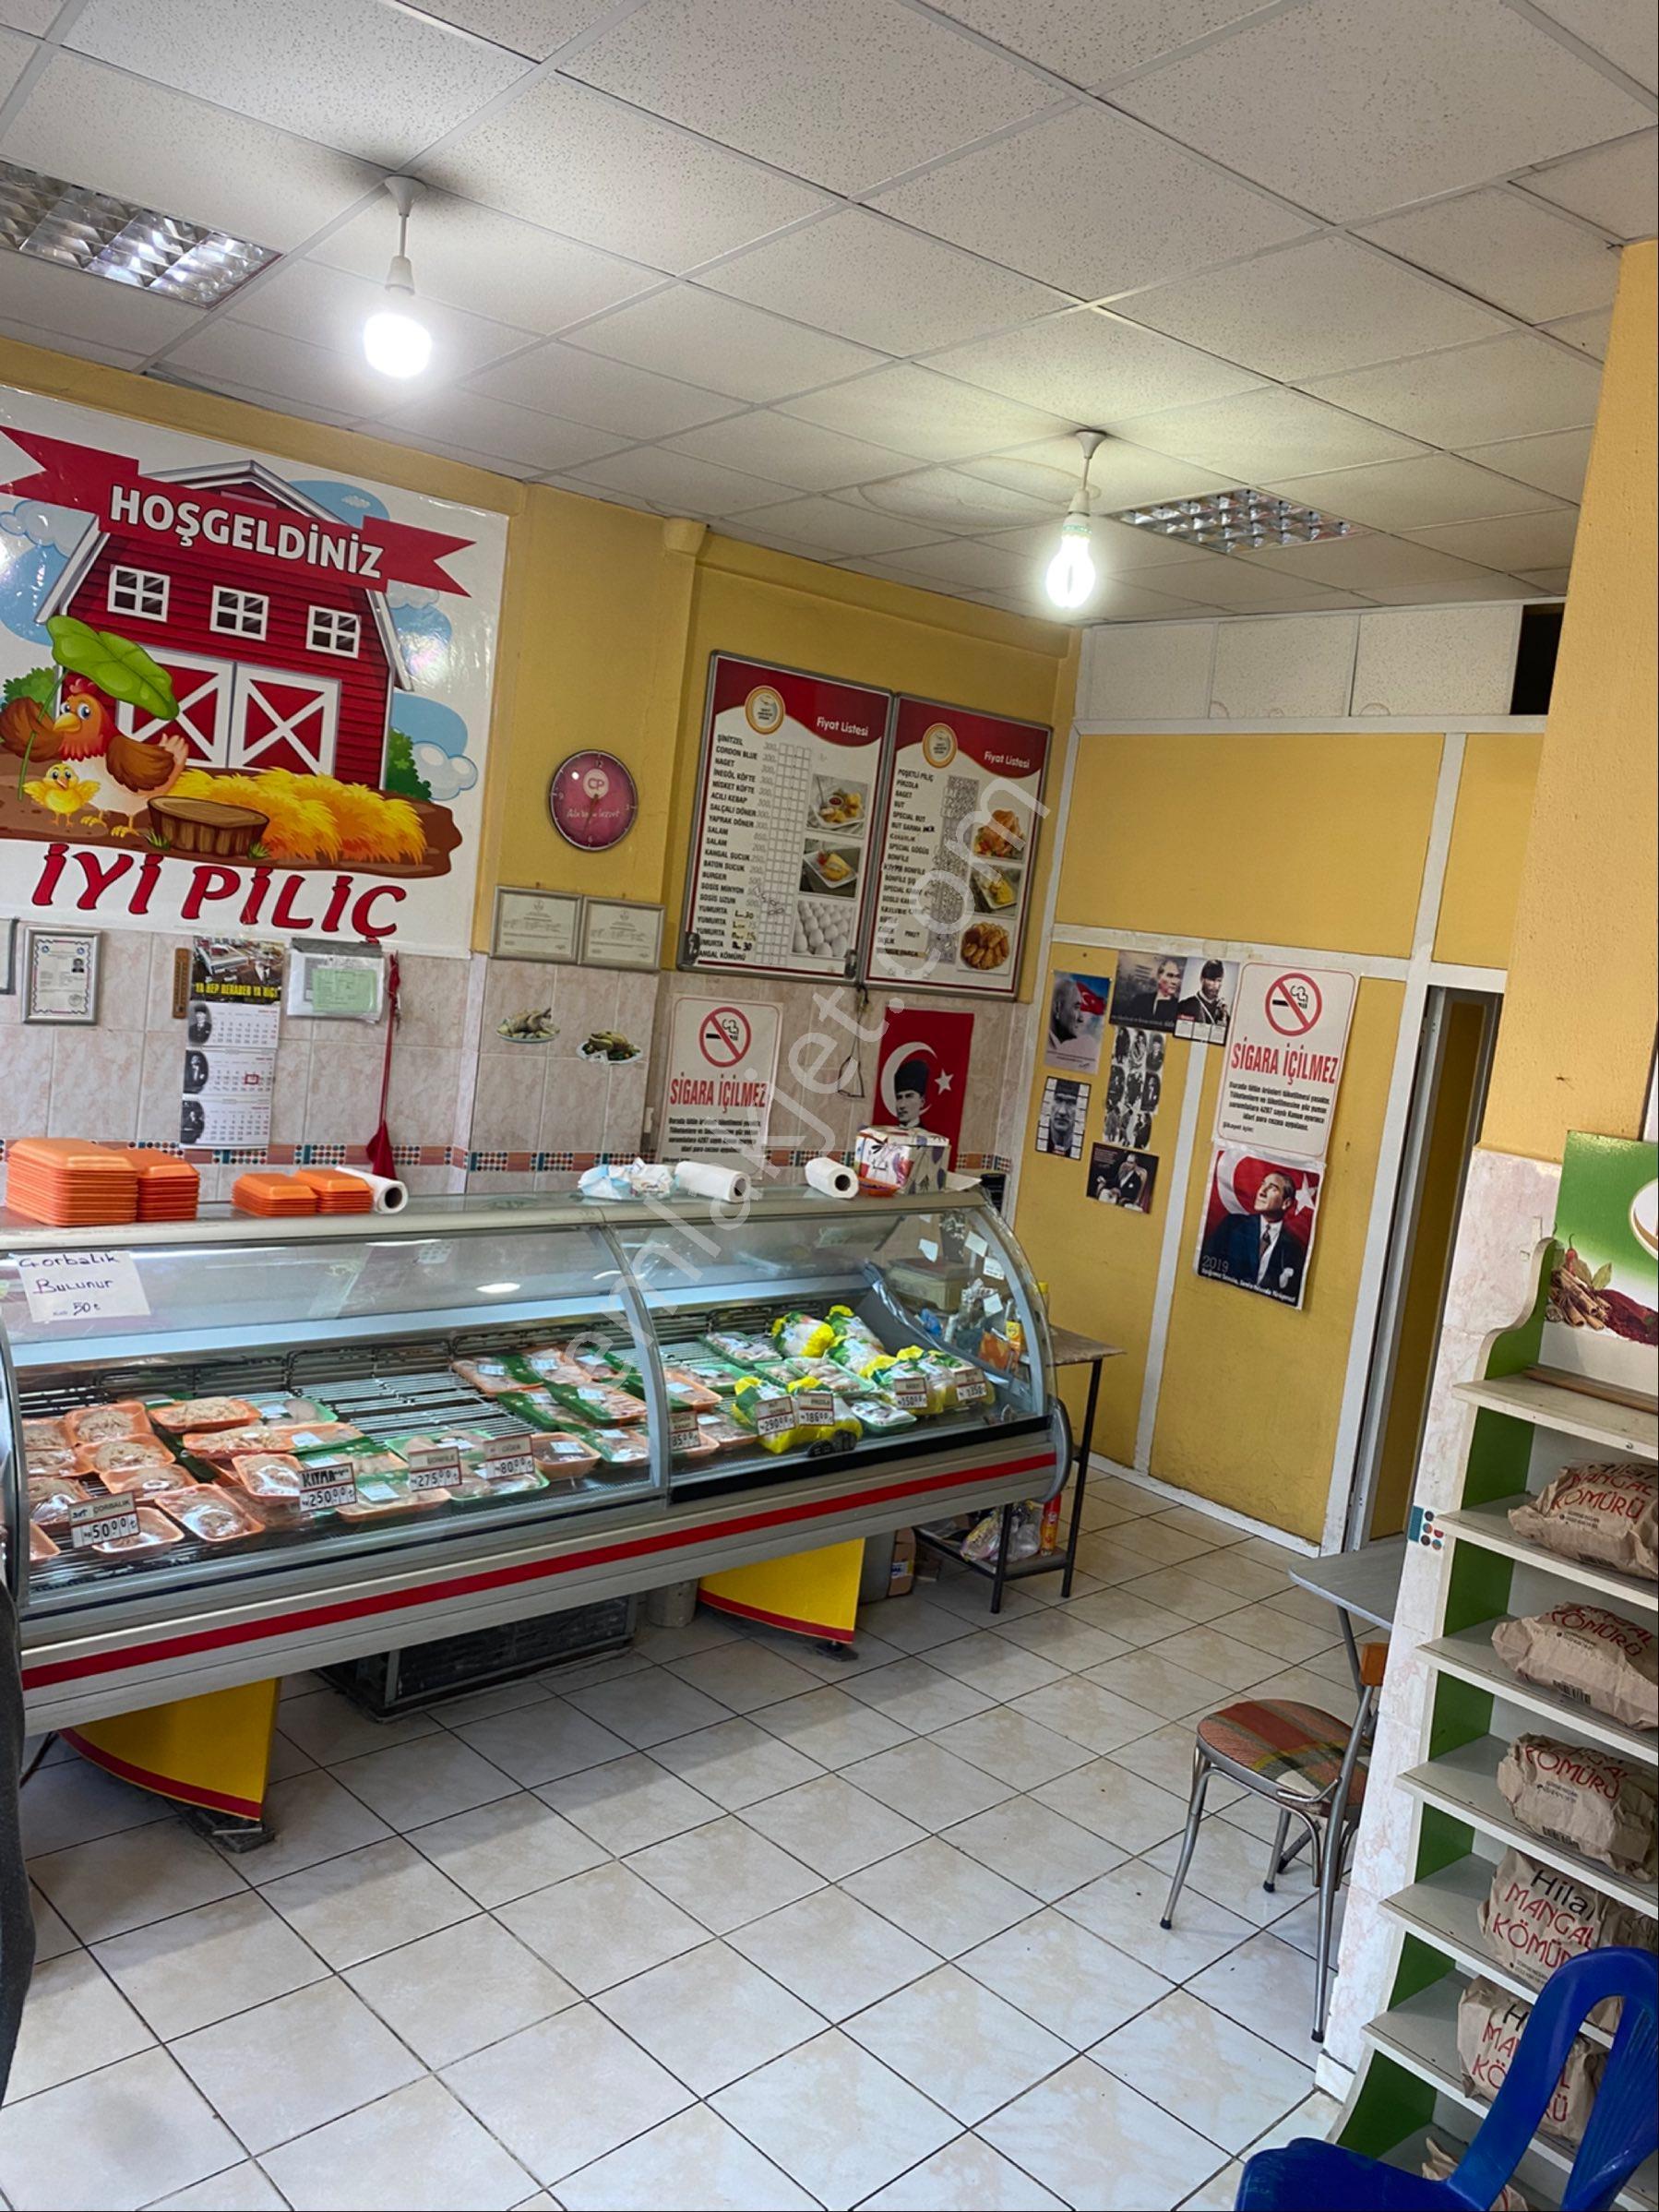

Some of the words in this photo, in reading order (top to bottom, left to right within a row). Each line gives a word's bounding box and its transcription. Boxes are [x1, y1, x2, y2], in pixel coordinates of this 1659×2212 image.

[111, 484, 384, 579] HOŞGELDİNİZ
[817, 716, 840, 731] Fiyat
[841, 722, 869, 736] Listesi
[984, 751, 1004, 764] Fiyat
[1006, 756, 1031, 769] Listesi
[709, 815, 731, 824] YAPRAK
[708, 826, 728, 835] SALAM
[707, 837, 727, 846] SALAM
[705, 849, 728, 858] KANGAL
[730, 853, 750, 861] SUCUK
[724, 862, 745, 872] SUCUK
[702, 871, 726, 880] BURGER
[31, 843, 164, 915] İYİ
[181, 865, 407, 943] PİLİÇ
[698, 905, 727, 915] YUMURTA
[698, 916, 726, 926] YUMURTA
[697, 927, 724, 937] YUMURTA
[699, 939, 723, 948] UMURTA
[699, 951, 718, 959] ANGAL
[1231, 1036, 1279, 1075] SİGARA
[1283, 1043, 1339, 1084] İÇİLMEZ
[670, 1071, 714, 1106] SİGARA
[718, 1074, 768, 1113] İÇİLMEZ
[1202, 1255, 1229, 1273] 2019
[1531, 1870, 1595, 1920] Hilal
[1505, 1883, 1593, 1950] MANGAL
